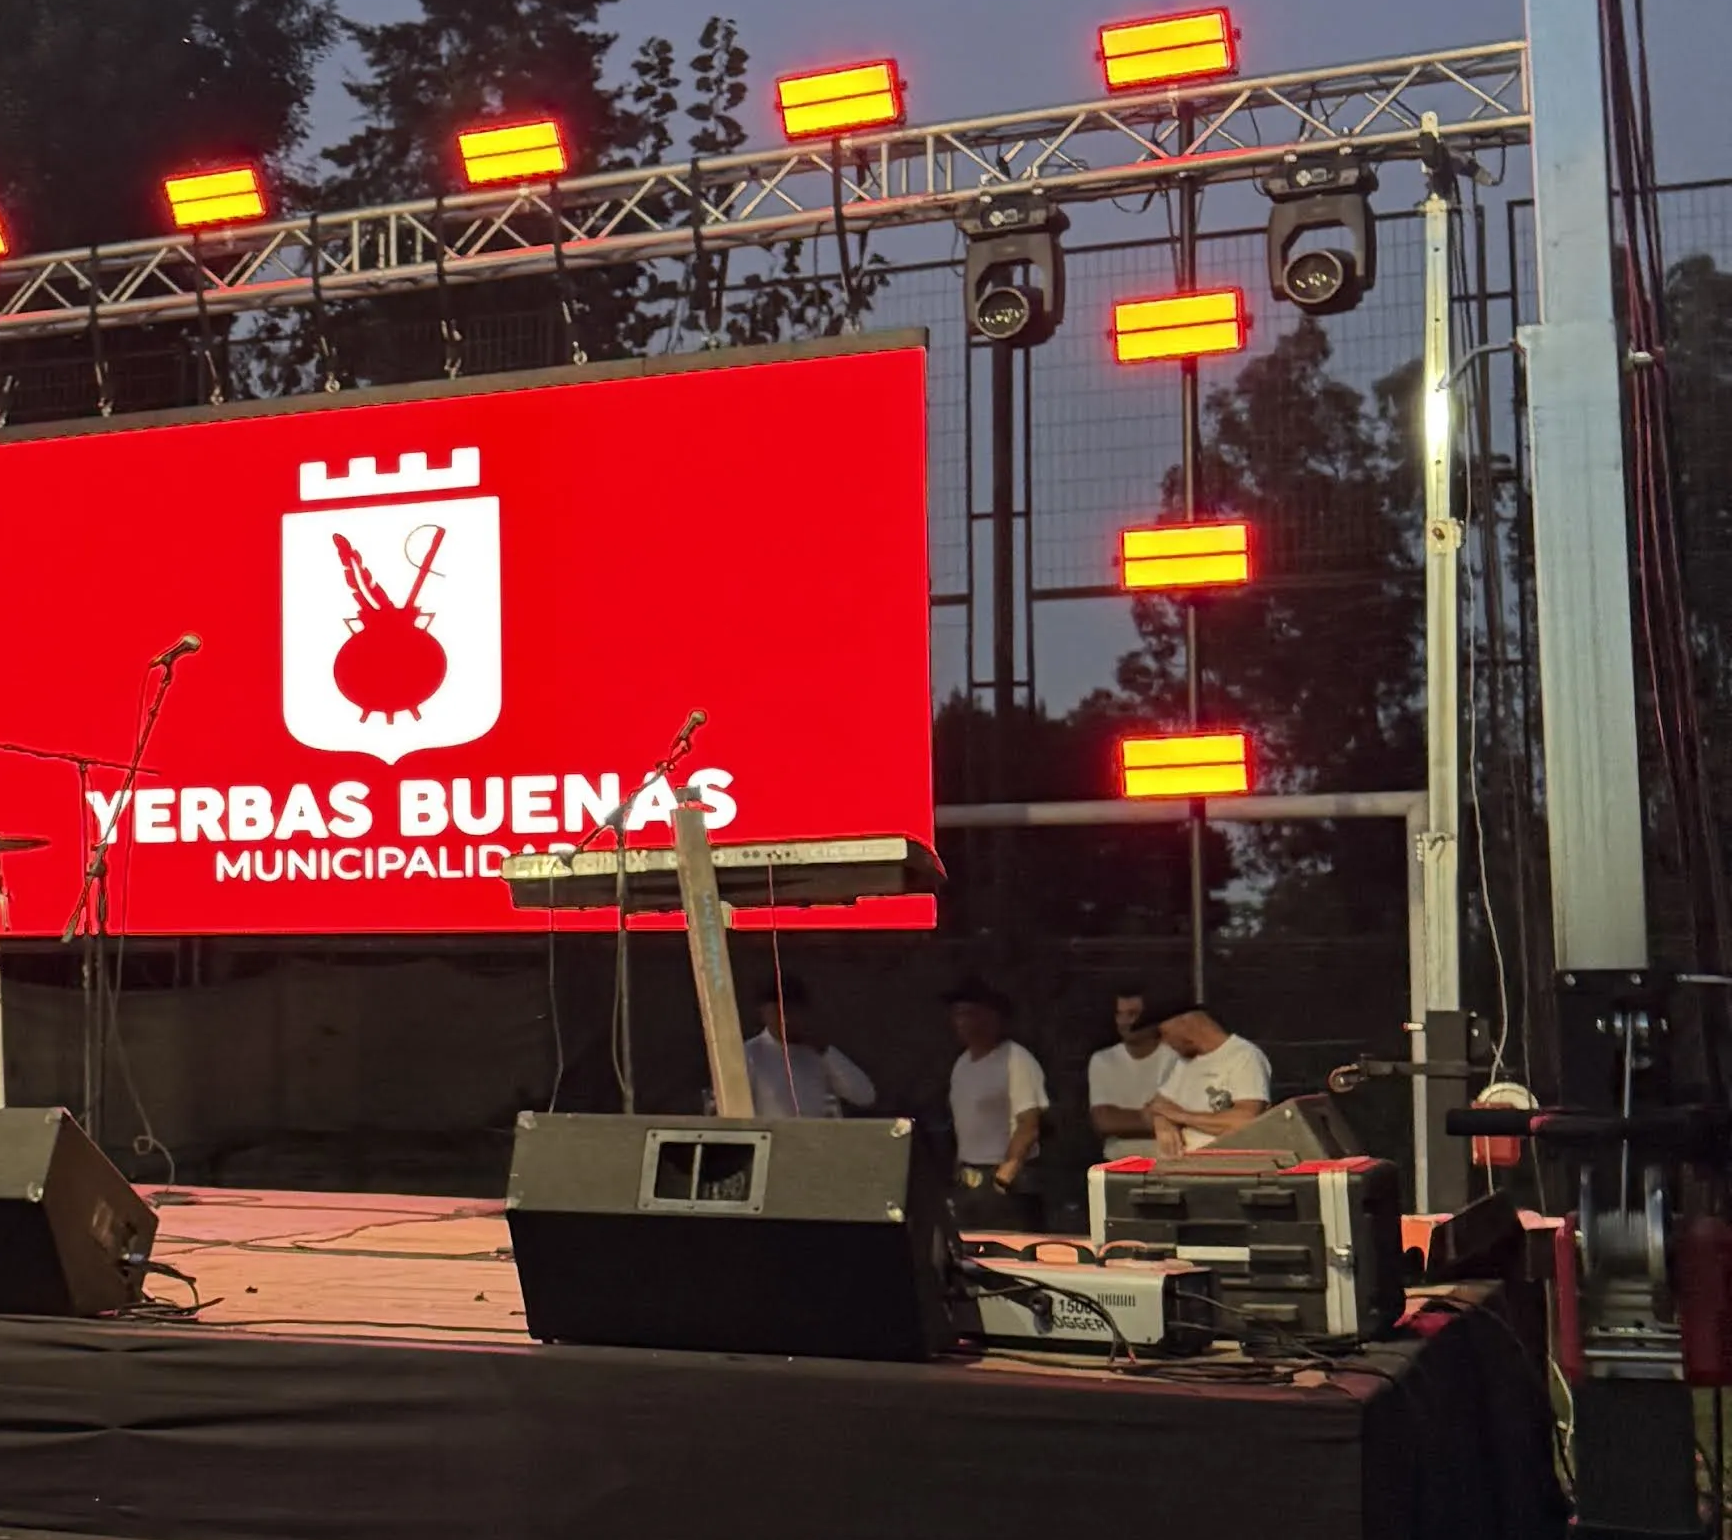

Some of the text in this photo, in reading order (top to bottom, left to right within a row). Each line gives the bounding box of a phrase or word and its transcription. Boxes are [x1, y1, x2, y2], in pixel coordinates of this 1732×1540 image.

[84, 767, 738, 844] YERBAS BUENAS
[215, 842, 578, 883] MUNICIPALID
[1053, 1314, 1108, 1332] OGGER
